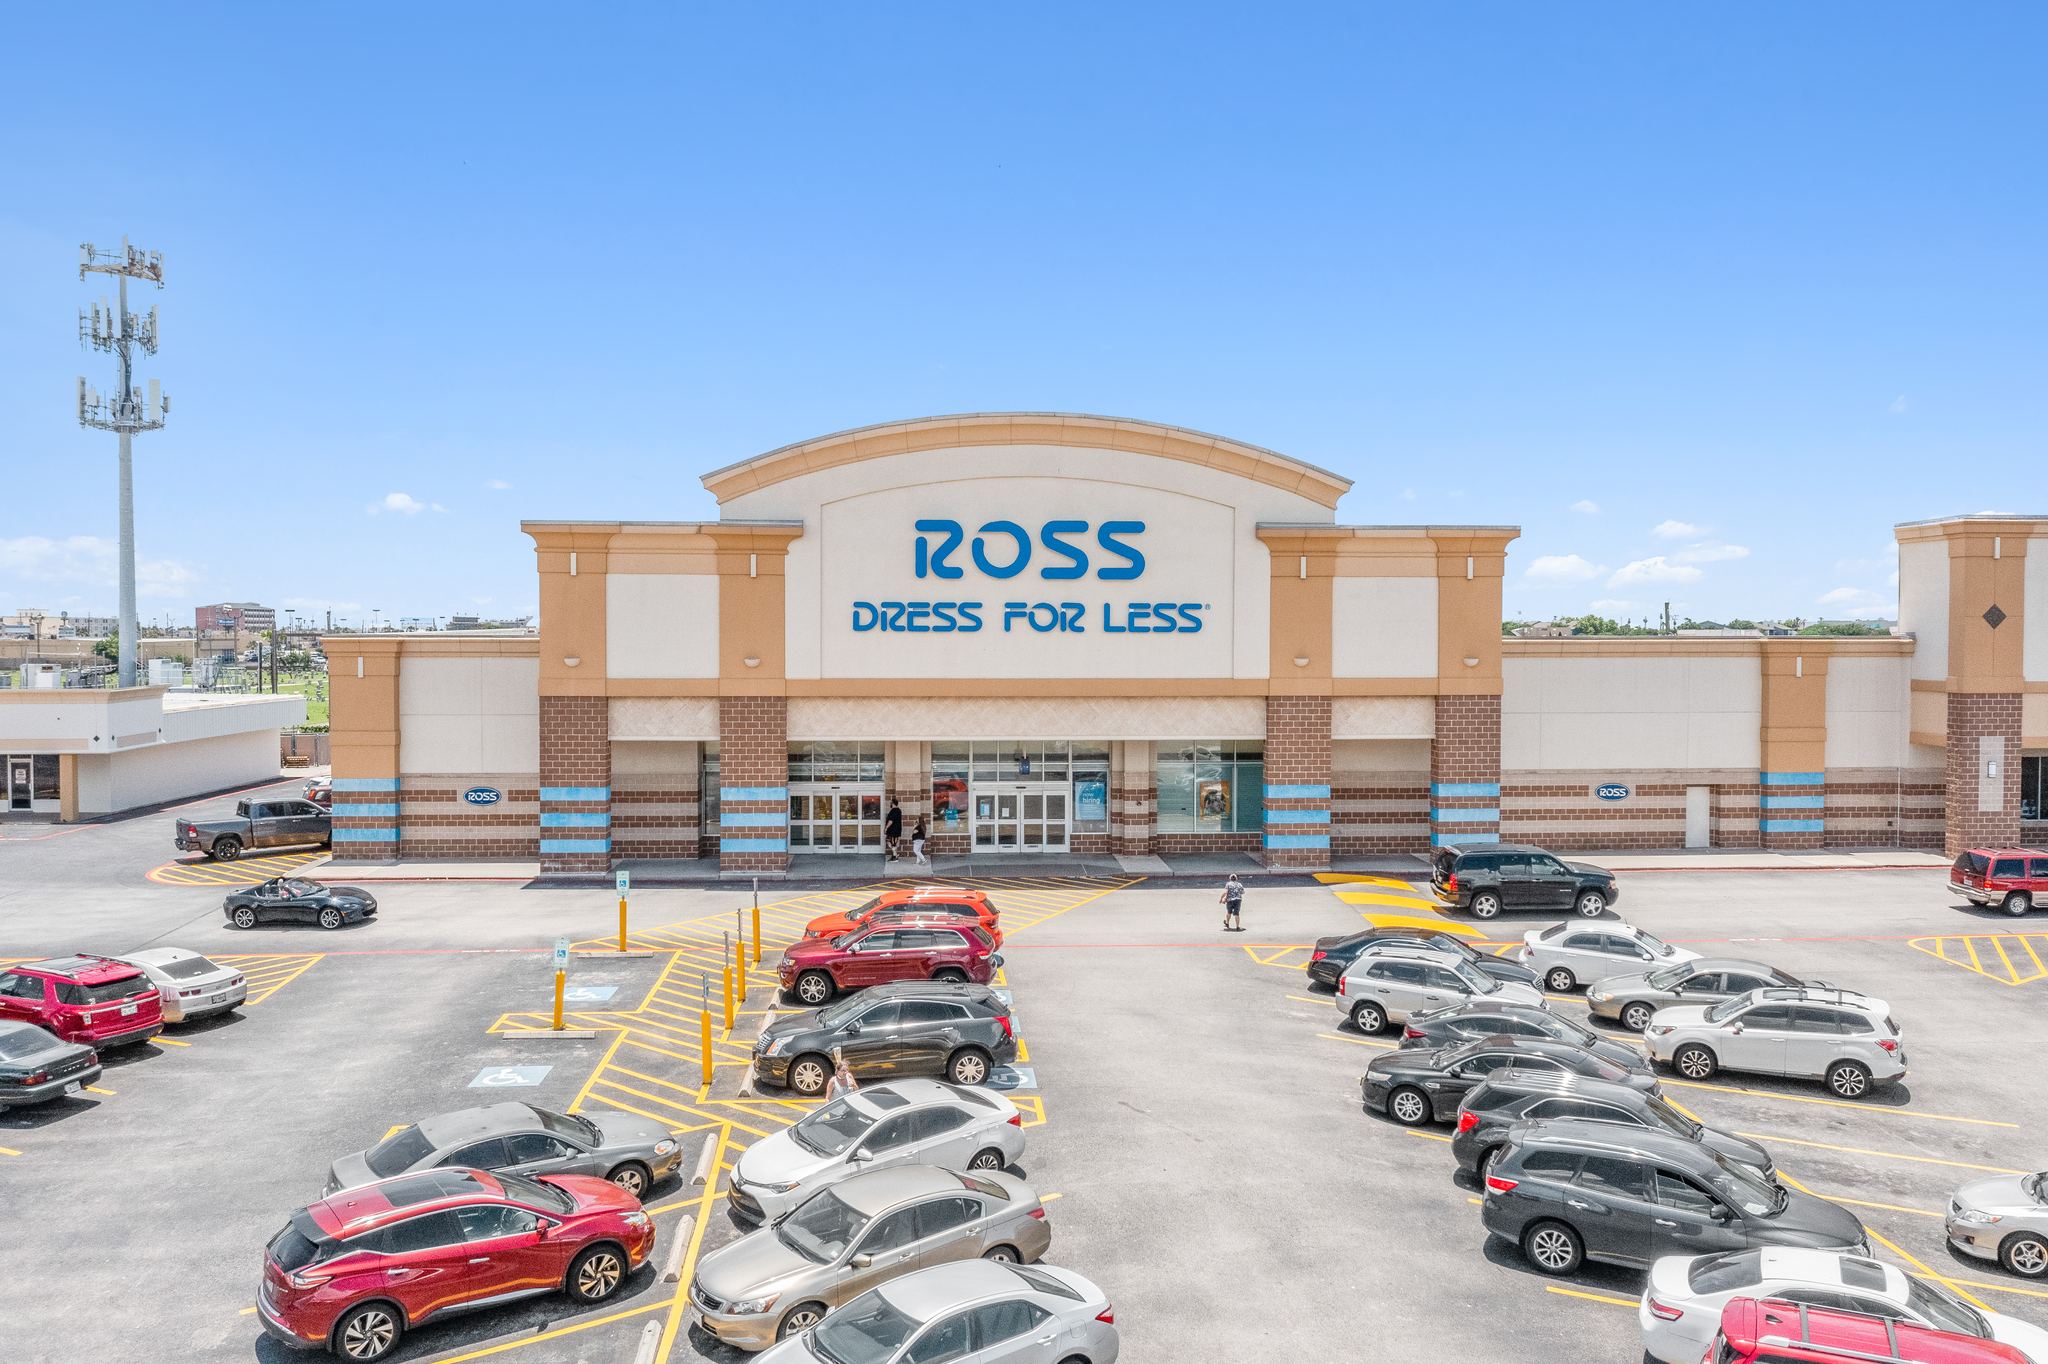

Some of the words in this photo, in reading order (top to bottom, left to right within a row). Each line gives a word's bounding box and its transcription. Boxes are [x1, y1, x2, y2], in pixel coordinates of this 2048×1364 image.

[914, 519, 1146, 581] ROSS
[852, 601, 983, 633] DRESS
[1003, 602, 1086, 633] FOR
[467, 792, 498, 801] ROSS
[1599, 788, 1627, 797] ROSS
[1082, 797, 1101, 805] hiring
